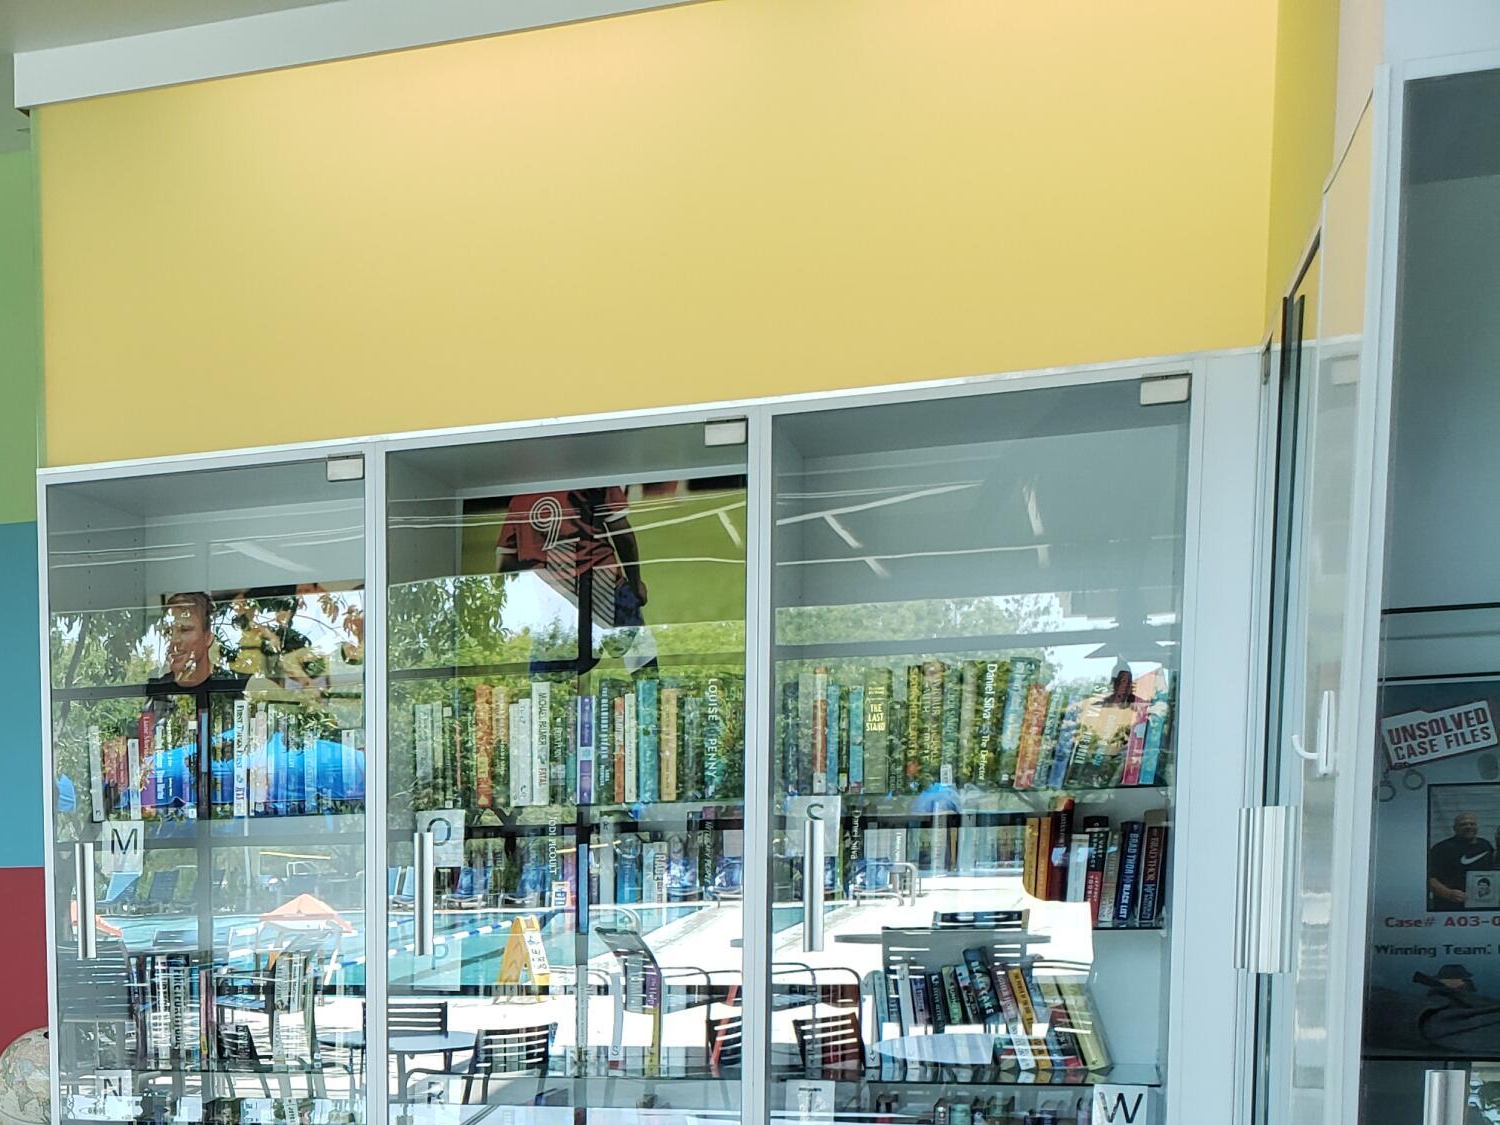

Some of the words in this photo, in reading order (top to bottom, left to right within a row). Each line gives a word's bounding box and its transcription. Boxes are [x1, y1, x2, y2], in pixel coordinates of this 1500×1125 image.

[529, 497, 562, 551] 9
[985, 664, 997, 694] Daniel
[539, 693, 547, 720] MICHAEL
[708, 678, 717, 721] LOUISE
[870, 704, 883, 712] THE
[982, 697, 995, 719] Silva
[866, 722, 885, 732] STAND
[868, 713, 884, 722] LAST
[1387, 707, 1489, 746] UNSOLVED
[539, 721, 547, 745] PALMER
[981, 735, 989, 747] The
[1394, 739, 1439, 761] CASE
[1444, 726, 1491, 750] FILES
[708, 738, 717, 778] PENNY
[978, 750, 989, 781] Defector
[539, 768, 547, 786] FATAL
[427, 817, 452, 846] O
[548, 816, 557, 836] JODI
[110, 828, 138, 855] M
[850, 840, 861, 860] Silva
[1089, 822, 1099, 868] CNSPIRACY
[1128, 833, 1139, 853] BRAD
[1147, 837, 1160, 859] BRAD
[548, 838, 557, 875] PICOULT
[1124, 854, 1137, 874] THOR
[1146, 859, 1158, 881] THOR
[1120, 884, 1132, 904] BLACK
[1118, 905, 1129, 919] LIST
[1385, 916, 1436, 929] Case#
[1374, 944, 1437, 958] Winning
[1443, 944, 1492, 956] Team:
[976, 989, 995, 1015] CAKE
[1099, 1092, 1144, 1124] W
